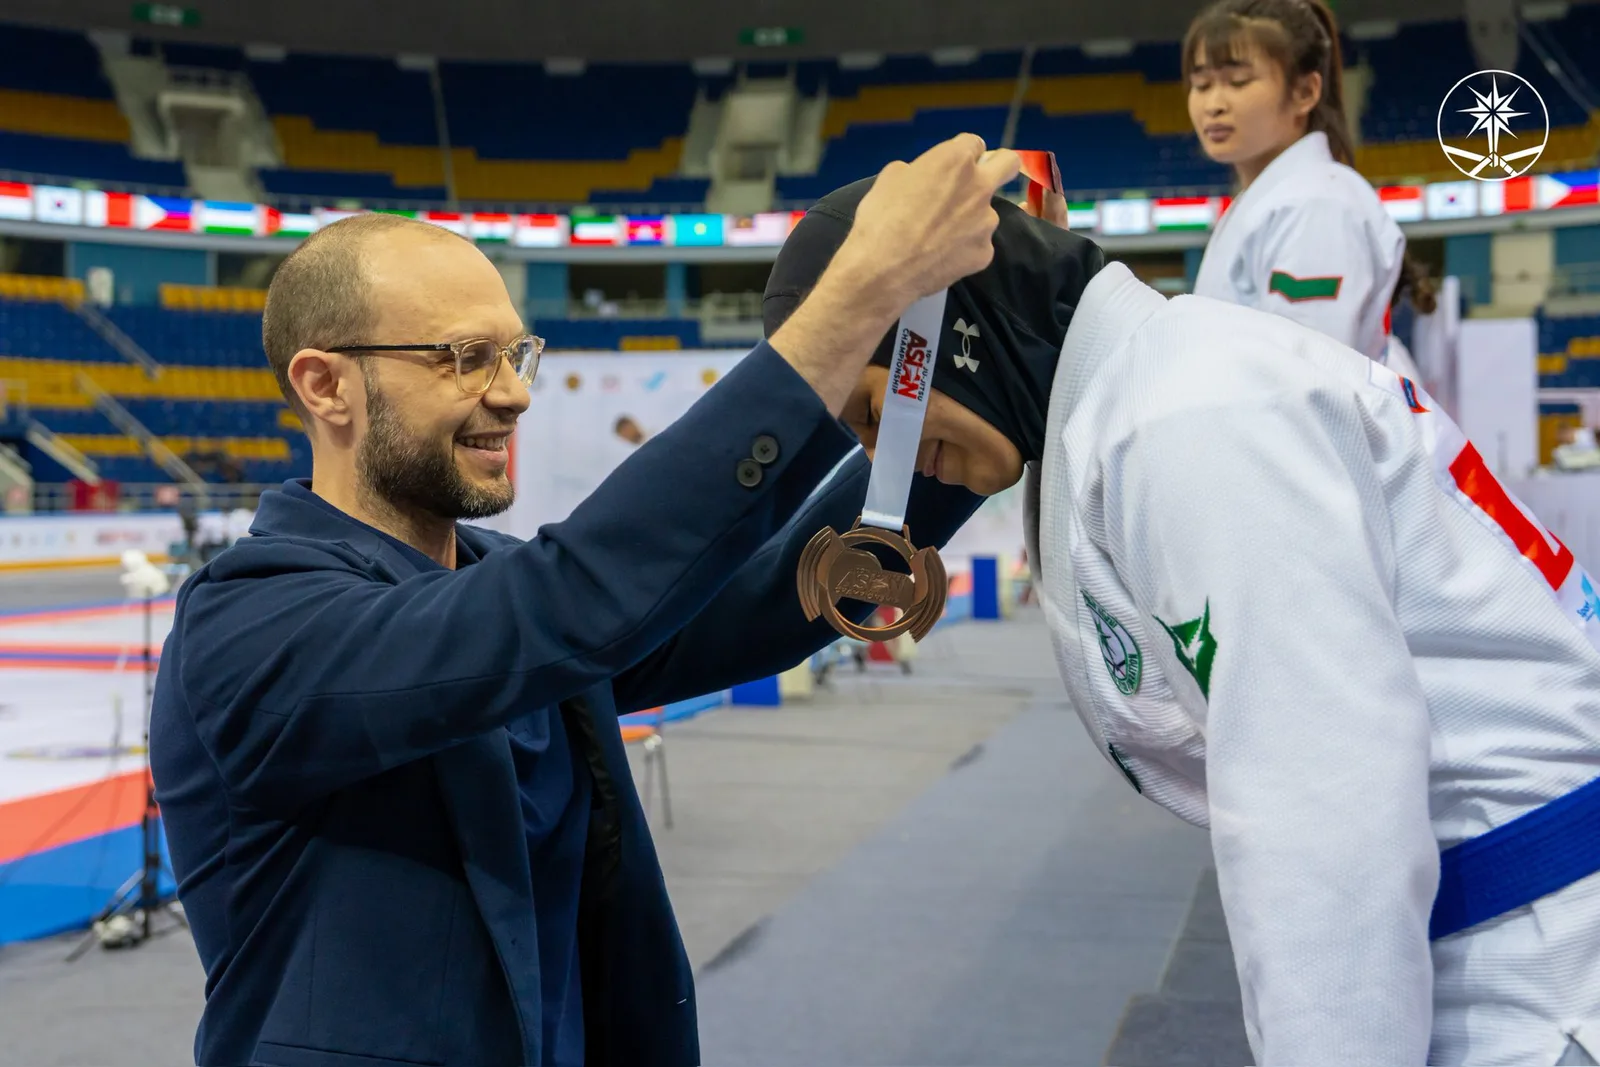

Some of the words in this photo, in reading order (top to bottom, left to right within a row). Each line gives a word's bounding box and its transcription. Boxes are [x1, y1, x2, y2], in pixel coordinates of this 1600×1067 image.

[892, 328, 909, 394] CHAMPIONSHIP
[897, 330, 928, 399] ASIAN
[917, 366, 929, 401] JU-JITSU
